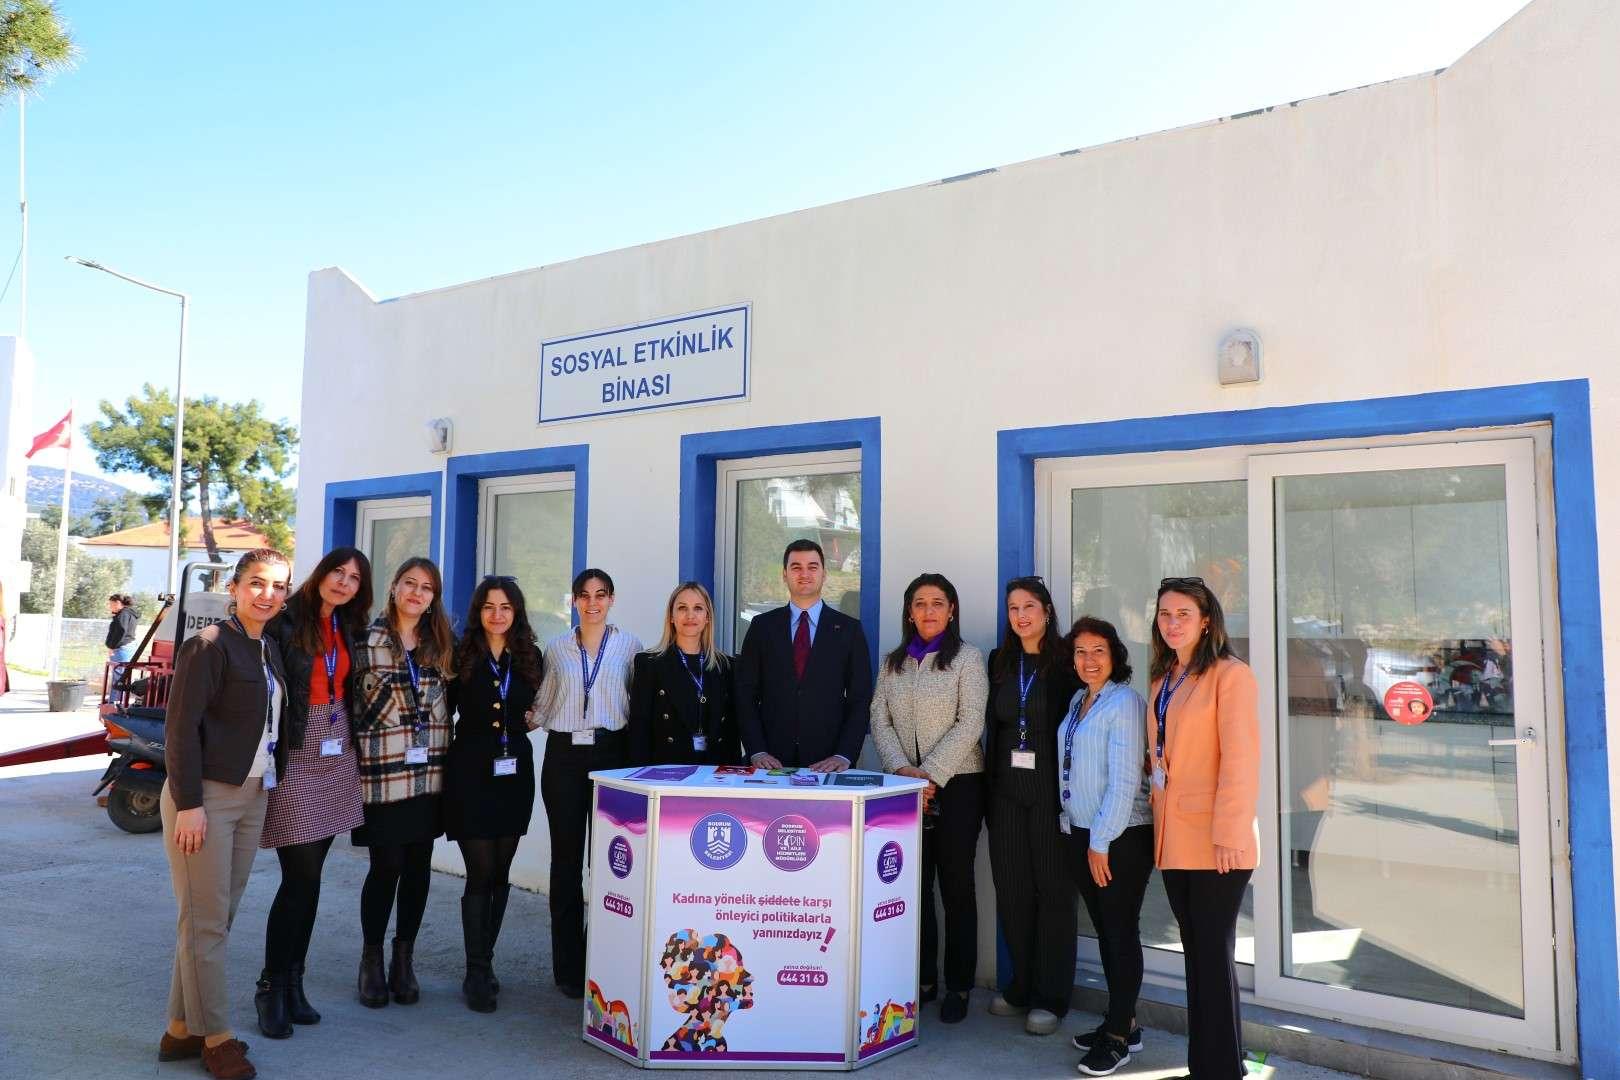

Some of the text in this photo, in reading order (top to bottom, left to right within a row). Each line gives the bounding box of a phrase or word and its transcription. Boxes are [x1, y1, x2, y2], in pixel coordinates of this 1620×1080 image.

[551, 324, 734, 377] SOSYAL ETKİNLİK
[602, 373, 671, 403] BİNASI
[672, 893, 832, 909] Kadına yönelik şiddete karşı
[715, 909, 832, 924] önleyici politikalarla
[780, 973, 825, 984] 444 31 63
